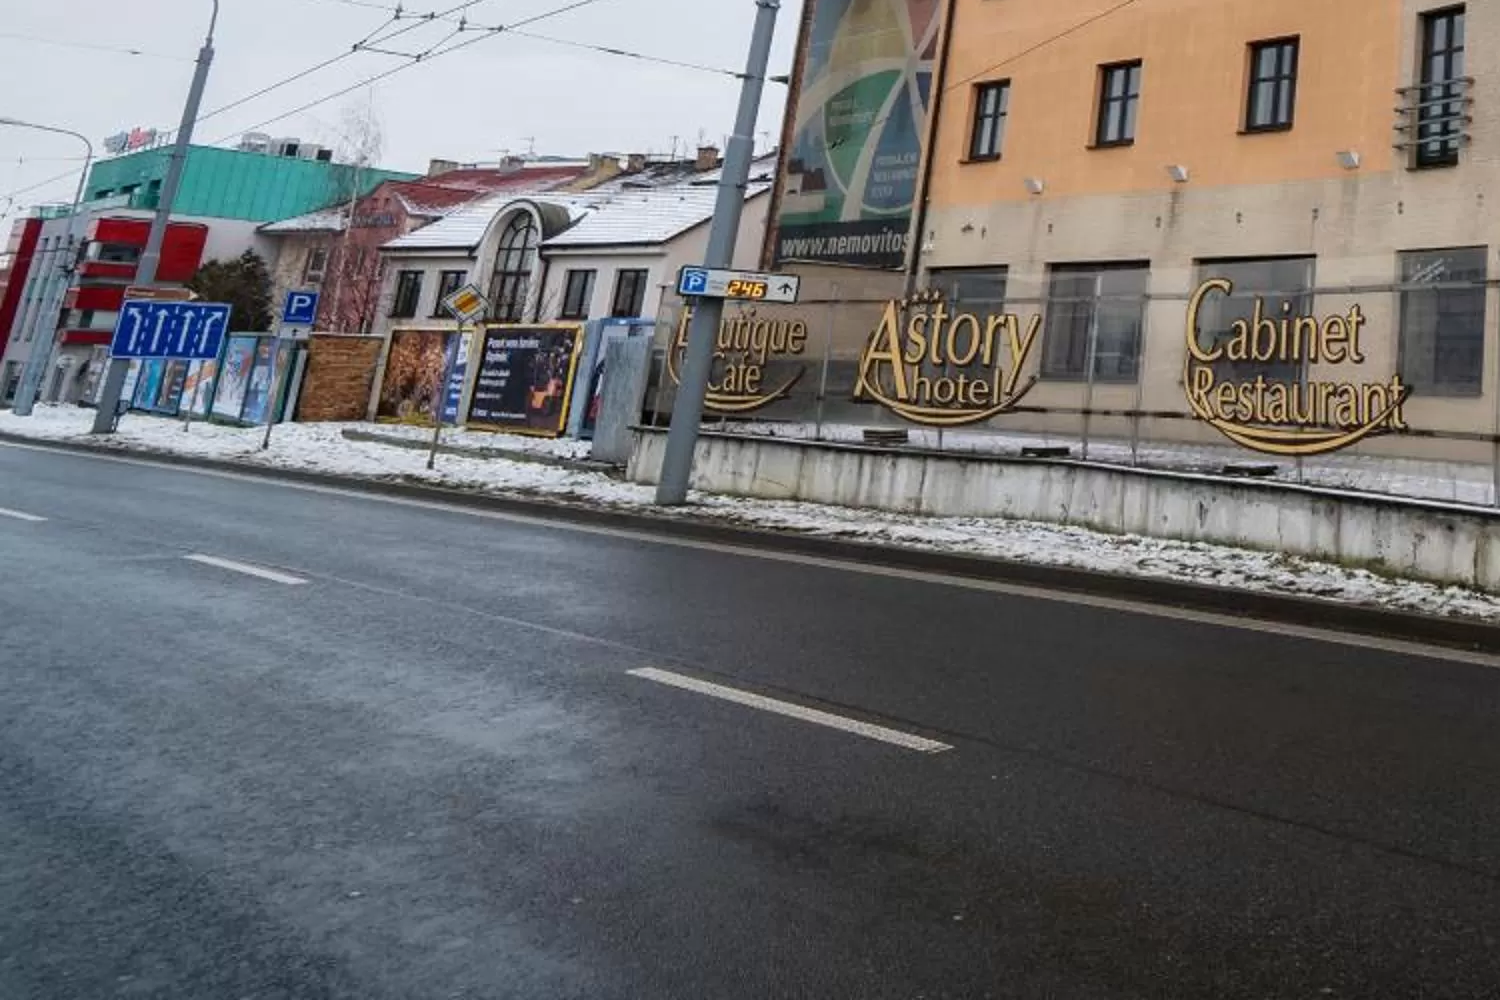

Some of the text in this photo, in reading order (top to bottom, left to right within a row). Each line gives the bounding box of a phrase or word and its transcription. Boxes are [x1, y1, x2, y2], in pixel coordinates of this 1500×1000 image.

[290, 295, 312, 314] P
[727, 280, 766, 298] 246
[1186, 277, 1365, 363] Cabinet
[678, 304, 808, 366] utique
[861, 299, 1041, 399] Astory
[912, 365, 1002, 405] hotel
[1193, 366, 1408, 429] Restaurant
